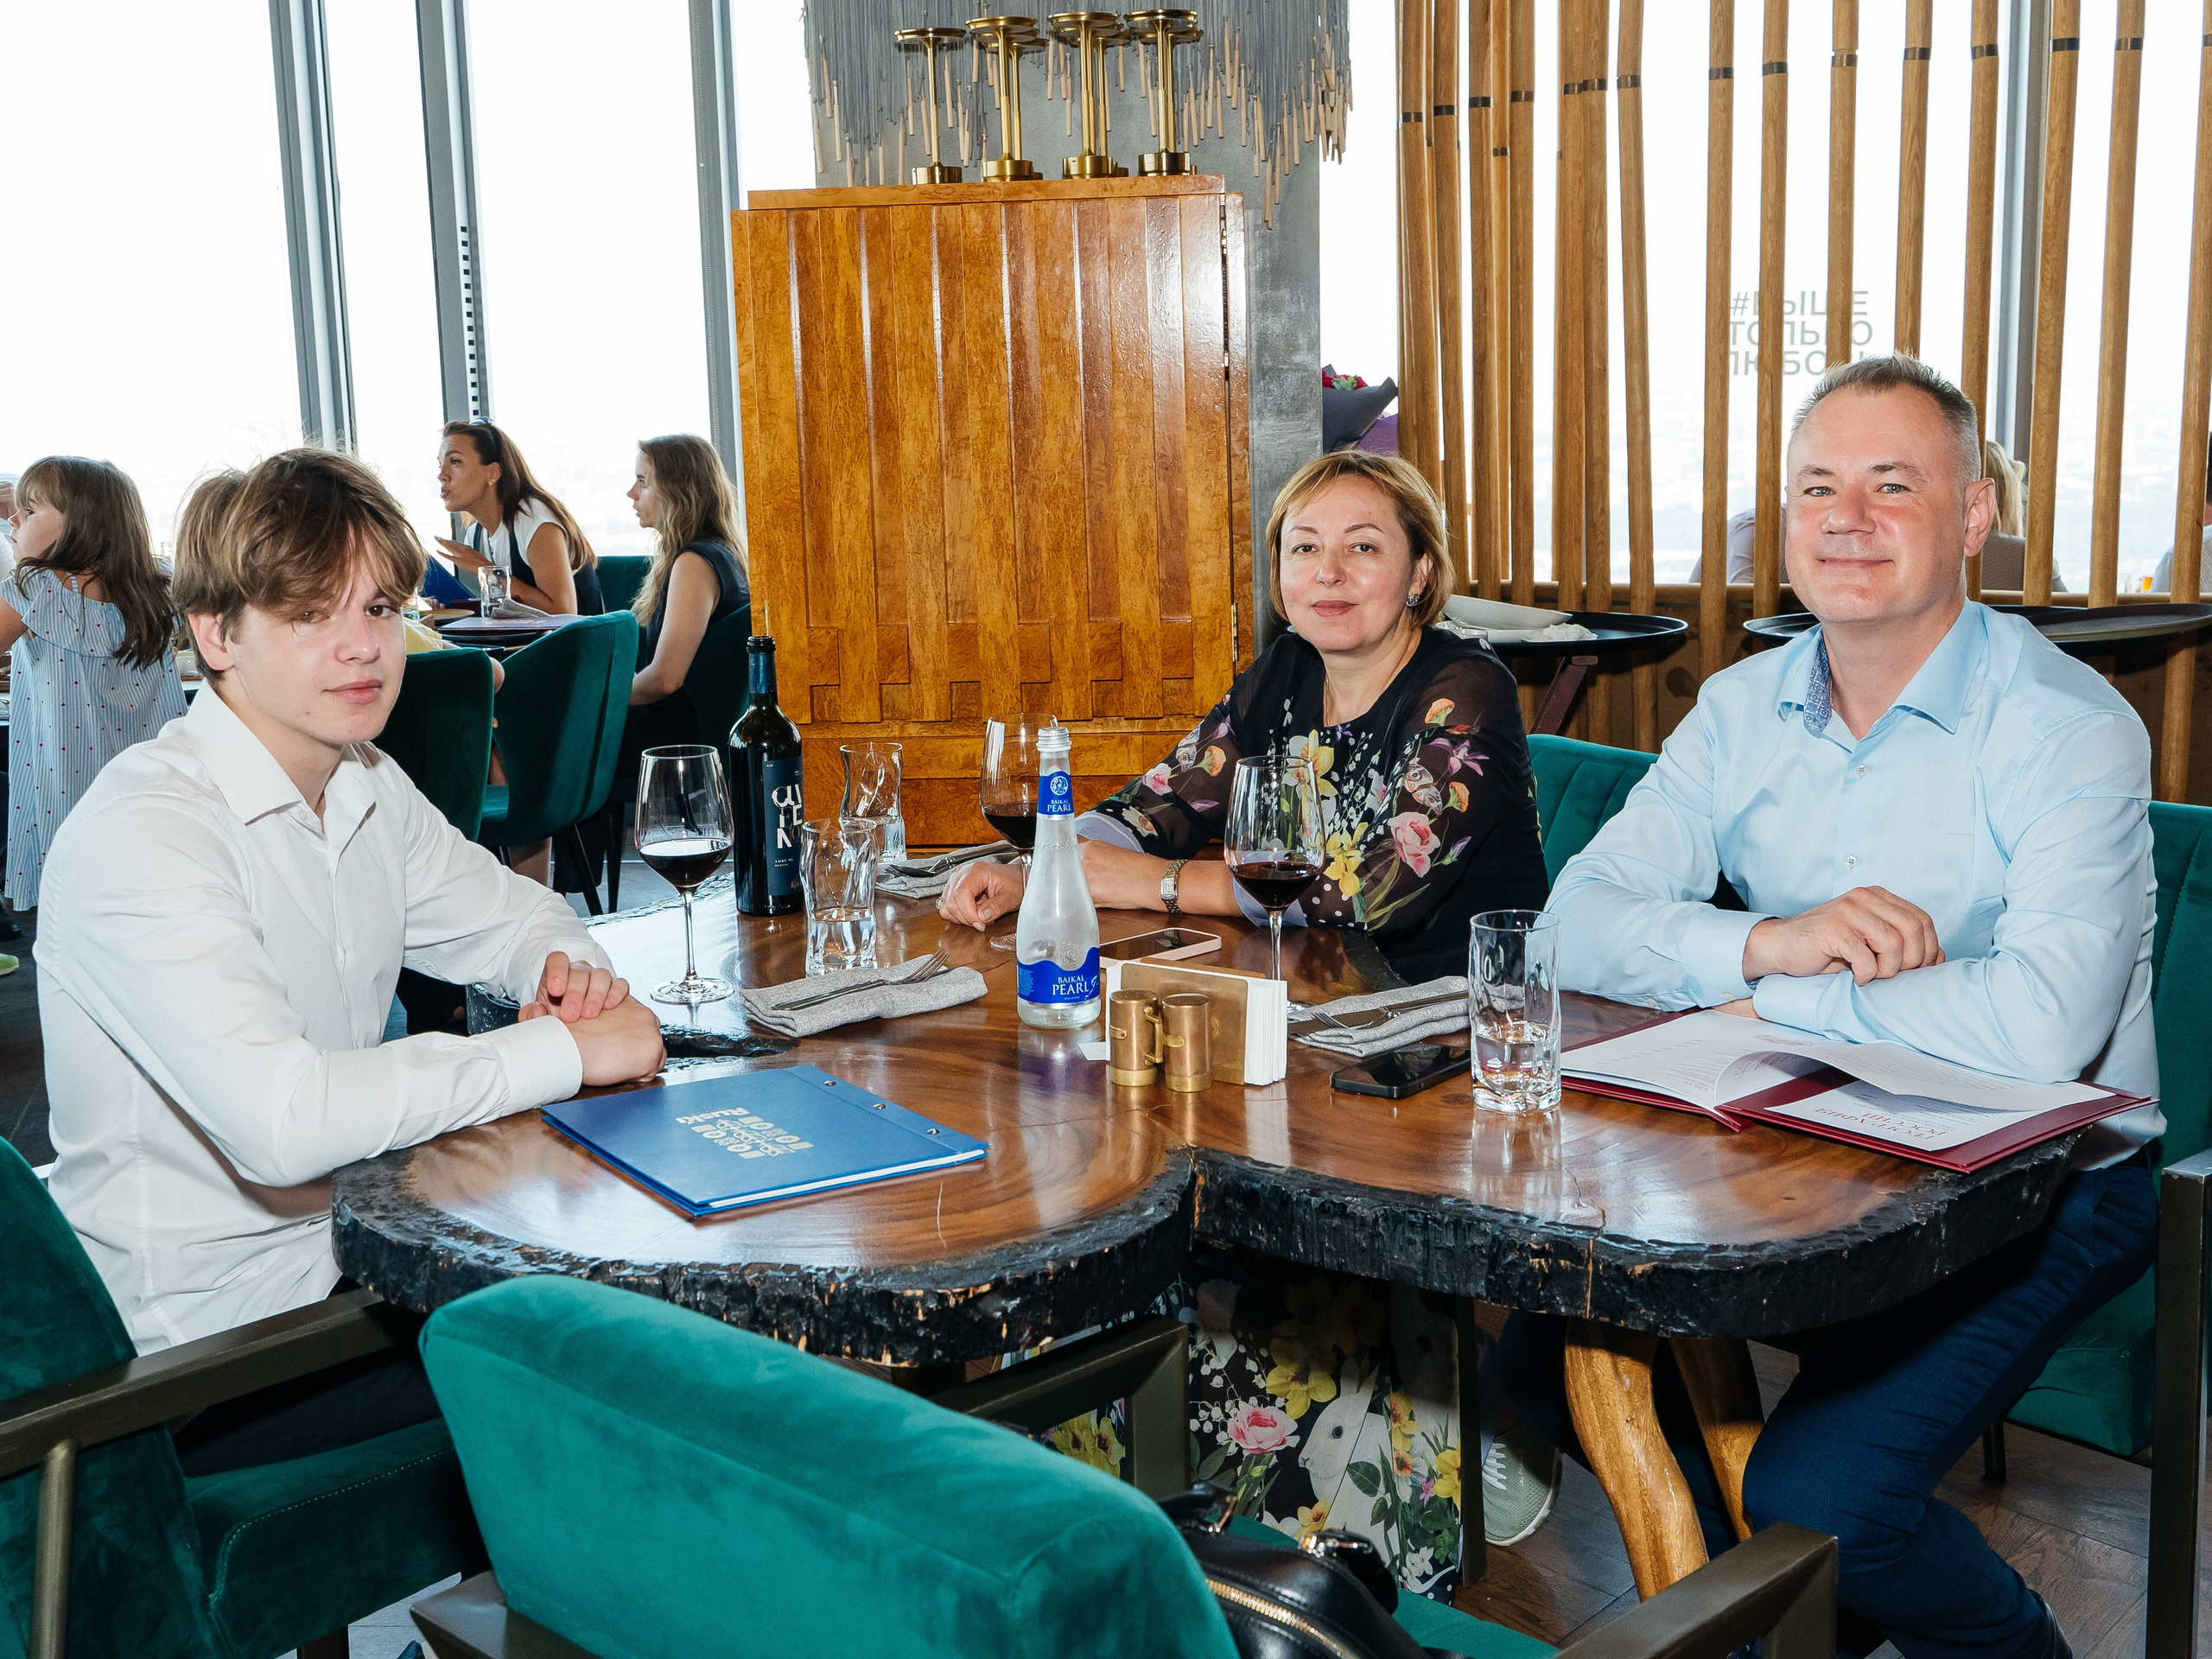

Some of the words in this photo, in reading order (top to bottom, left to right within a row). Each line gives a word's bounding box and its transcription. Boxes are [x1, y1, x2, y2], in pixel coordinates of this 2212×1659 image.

[1046, 804, 1072, 812] PEARL
[1058, 975, 1085, 984] BAIKAL
[1052, 981, 1090, 995] PEARL
[1814, 1108, 1934, 1140] ГЕОГРАФИЯ
[1861, 1112, 1948, 1136] РОССИИ
